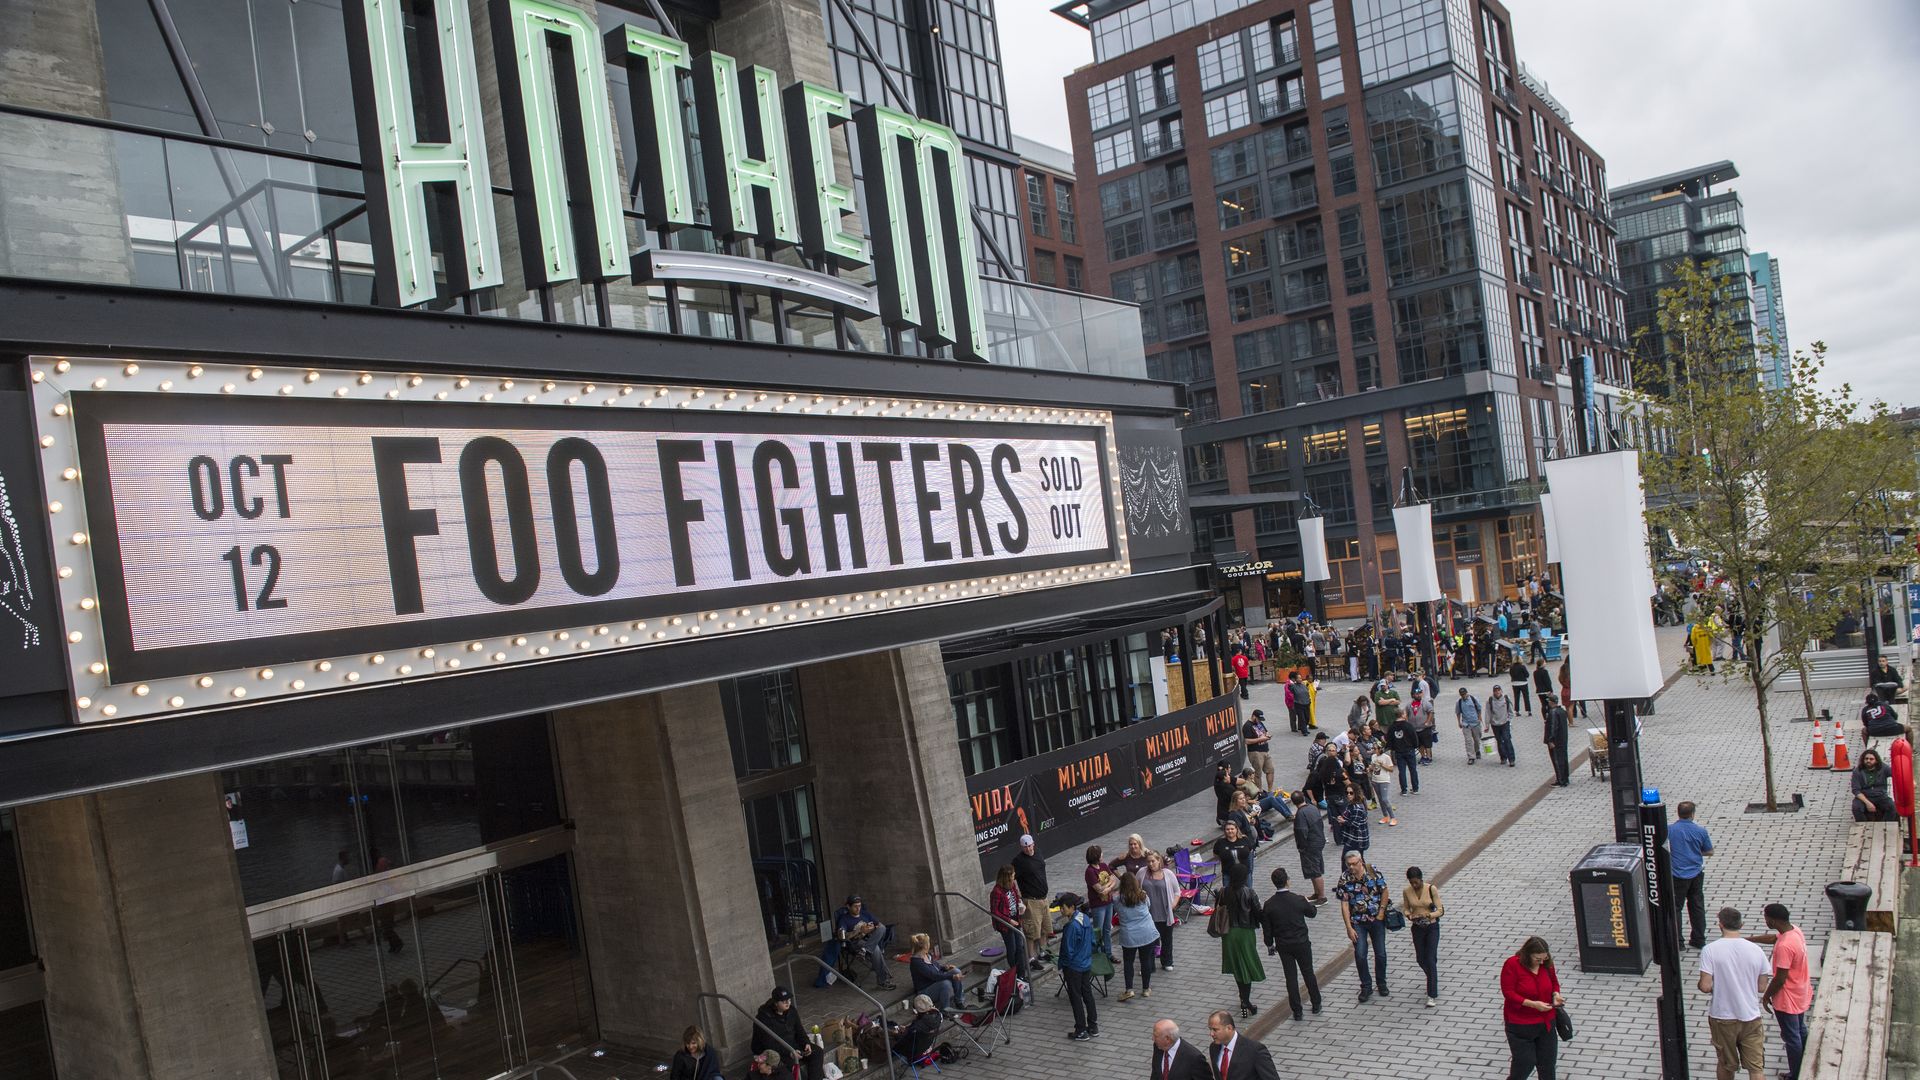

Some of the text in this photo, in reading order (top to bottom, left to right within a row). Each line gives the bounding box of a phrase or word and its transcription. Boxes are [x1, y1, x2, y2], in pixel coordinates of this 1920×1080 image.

[188, 454, 293, 521] OCT
[1040, 456, 1083, 492] SOLD
[371, 435, 1029, 615] FOO FIGHTERS
[1050, 503, 1083, 541] OUT
[222, 544, 289, 612] 12
[1220, 560, 1274, 574] TAYLOR
[1227, 569, 1268, 578] GOURMET
[1213, 737, 1229, 750] COMING
[1155, 760, 1174, 774] COMING
[1174, 756, 1187, 767] SOON
[971, 785, 1015, 821] VIDA
[1068, 792, 1092, 808] COMING
[1092, 786, 1108, 799] SOON
[976, 830, 989, 843] ING
[989, 822, 1009, 838] SOON
[1643, 824, 1660, 907] Emergency
[1607, 883, 1630, 948] pitches in
